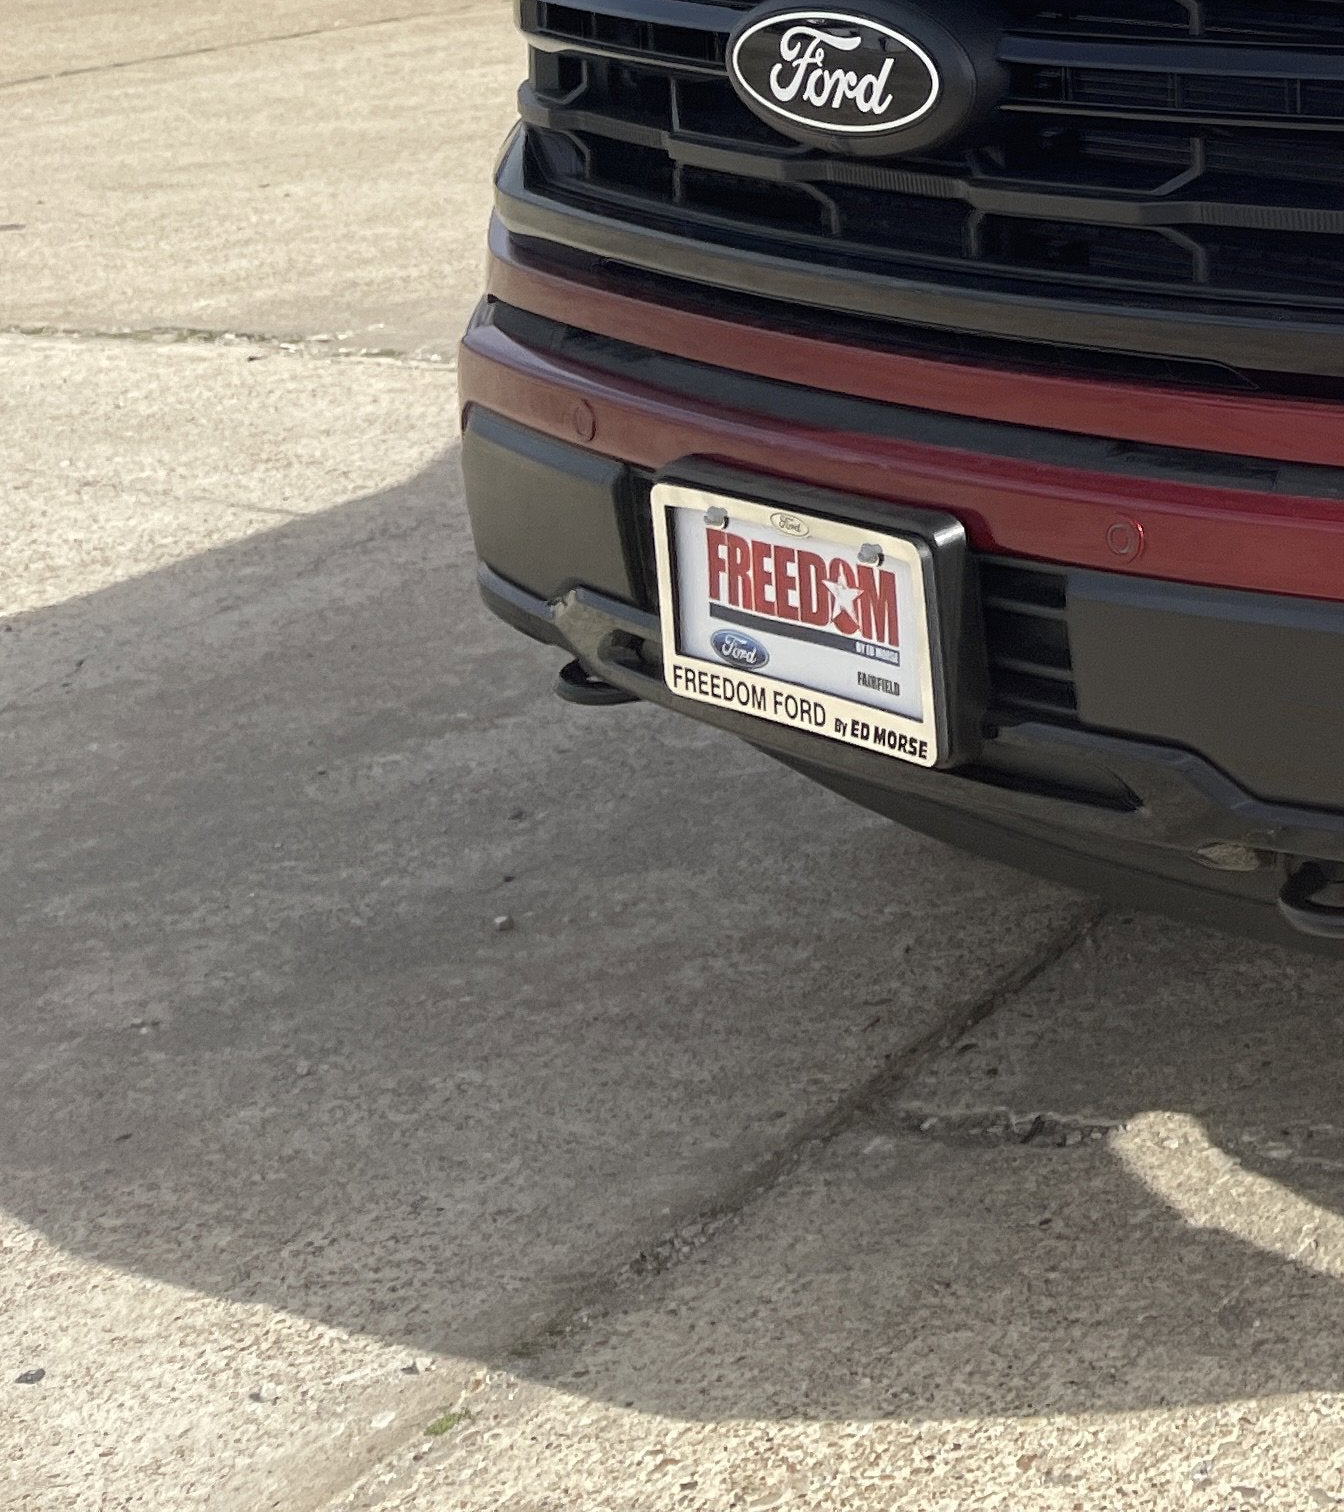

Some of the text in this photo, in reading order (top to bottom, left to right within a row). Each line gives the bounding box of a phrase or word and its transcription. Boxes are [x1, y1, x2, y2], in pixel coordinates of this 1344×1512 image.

[770, 25, 895, 115] Ford
[777, 514, 802, 533] Ford
[706, 527, 900, 647] FREEDOM
[720, 637, 758, 665] Ford
[673, 665, 767, 712] FREEDOM
[773, 691, 826, 727] FORD
[851, 719, 870, 741] ED
[874, 726, 928, 760] MORSE
[857, 671, 900, 696] FAIRFIELD
